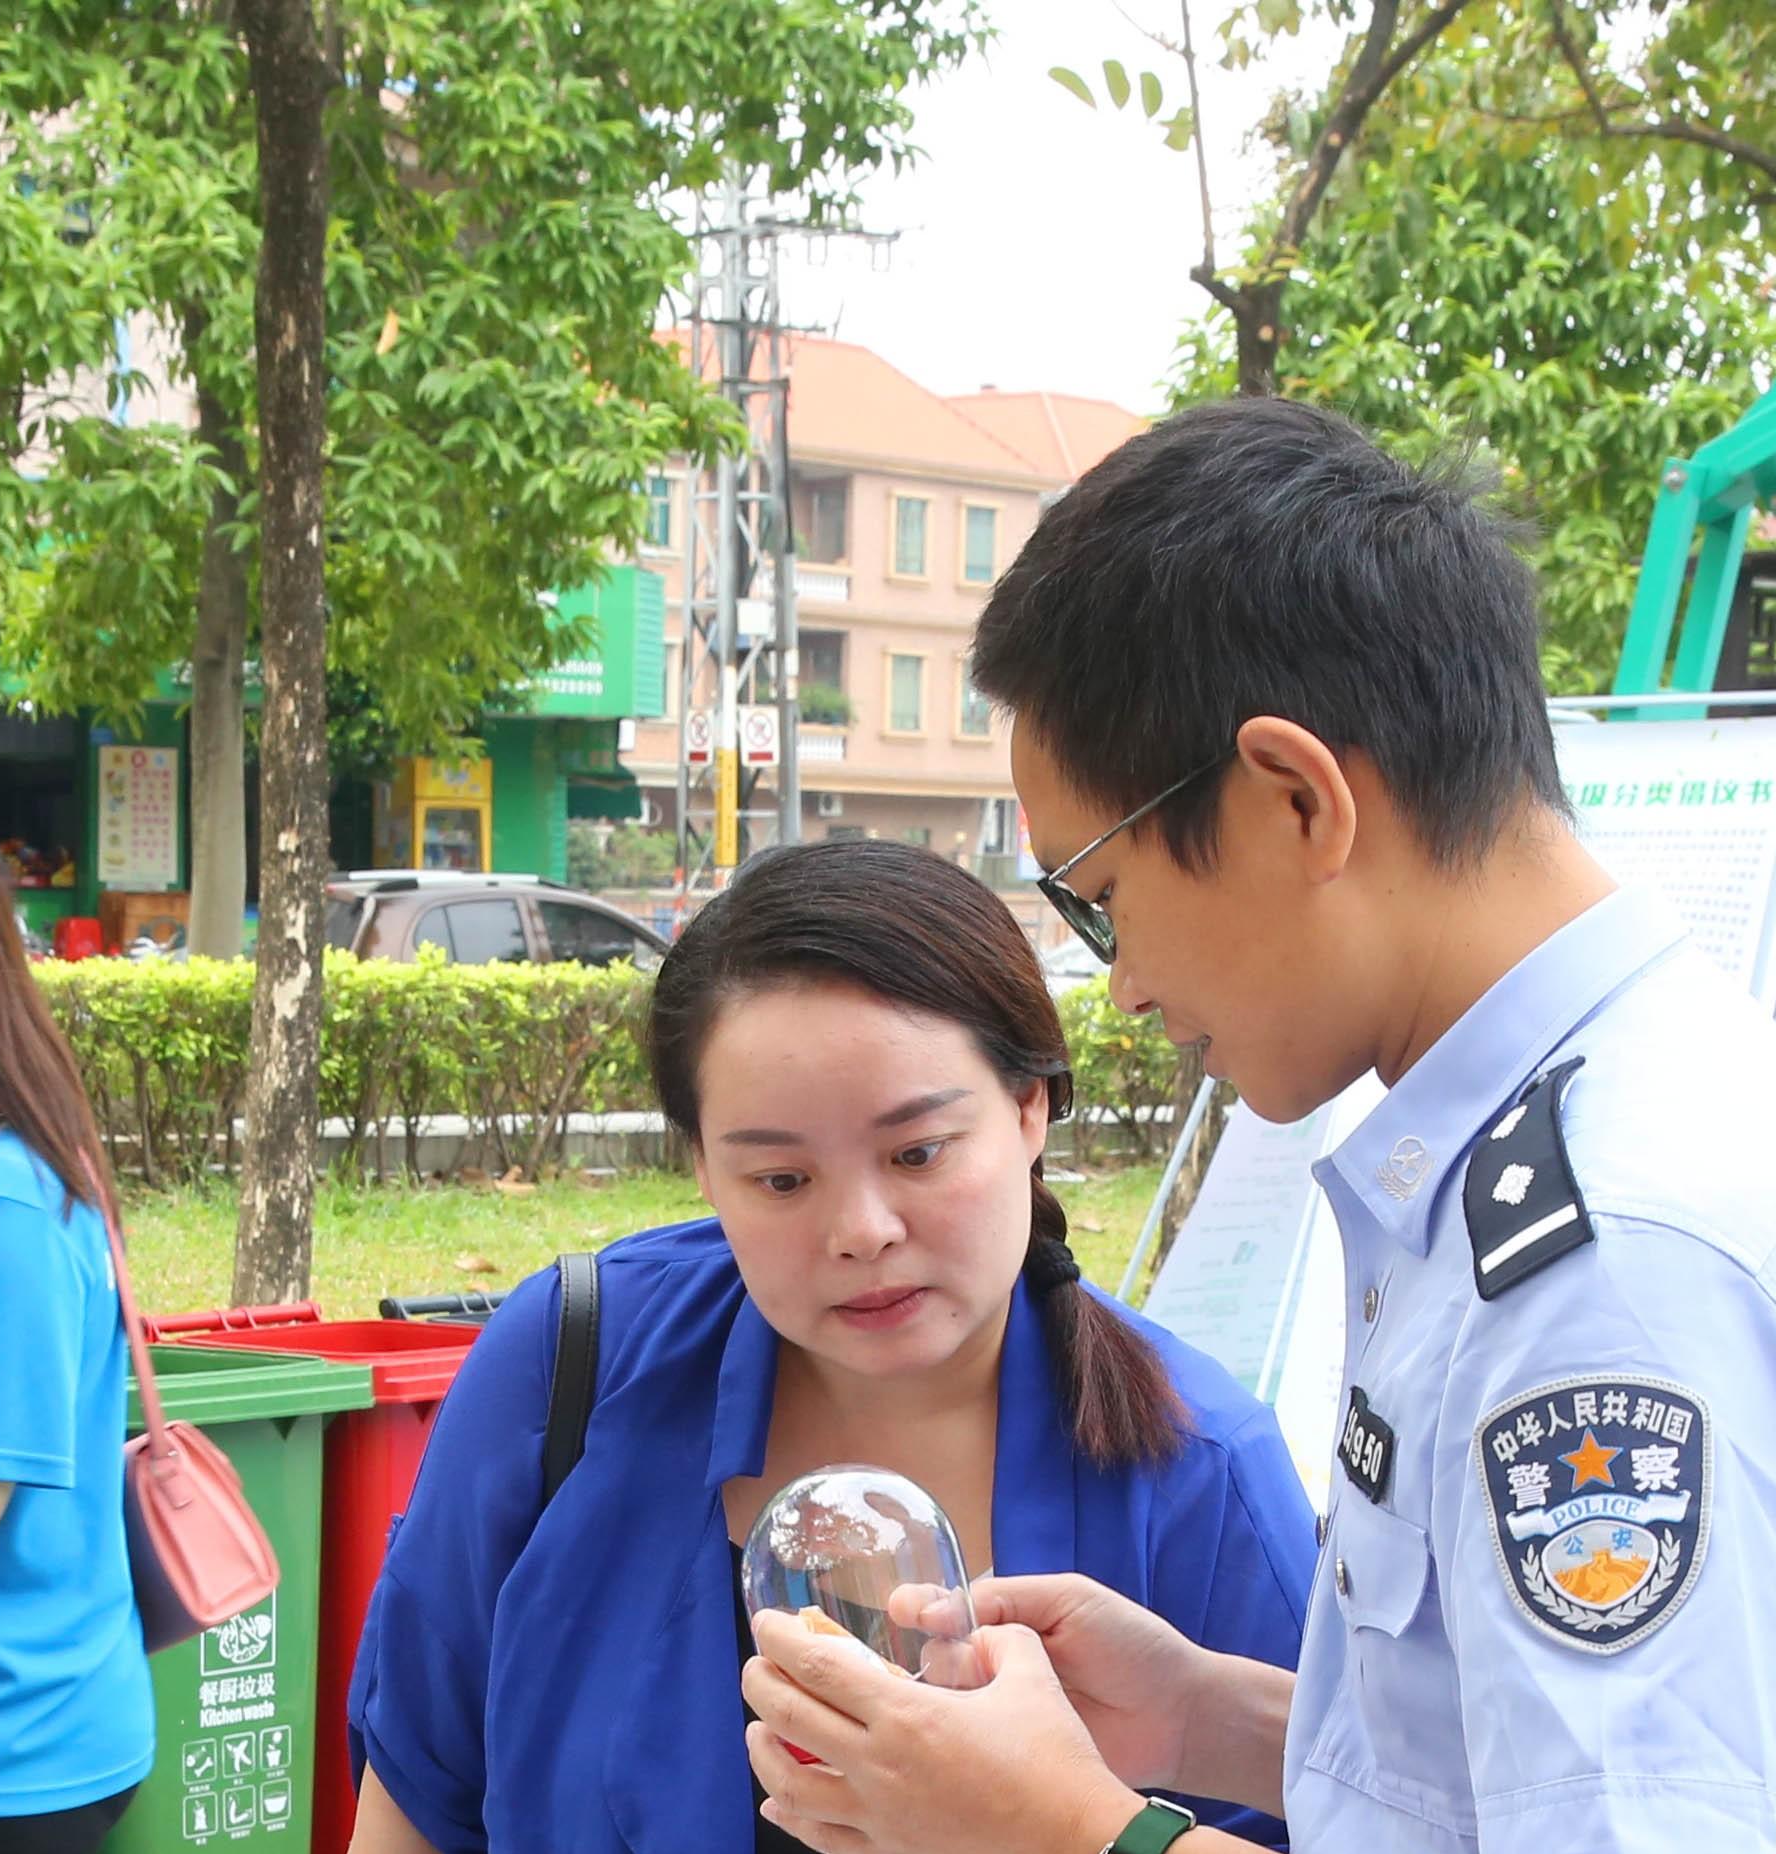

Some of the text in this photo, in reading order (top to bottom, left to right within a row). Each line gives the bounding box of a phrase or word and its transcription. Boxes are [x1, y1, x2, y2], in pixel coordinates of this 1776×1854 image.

[1491, 1390, 1694, 1464] 中华人民共和国
[1551, 1496, 1642, 1529] POLICE
[199, 1672, 275, 1707] 餐厨垃圾
[199, 1700, 275, 1728] Kitchen waste
